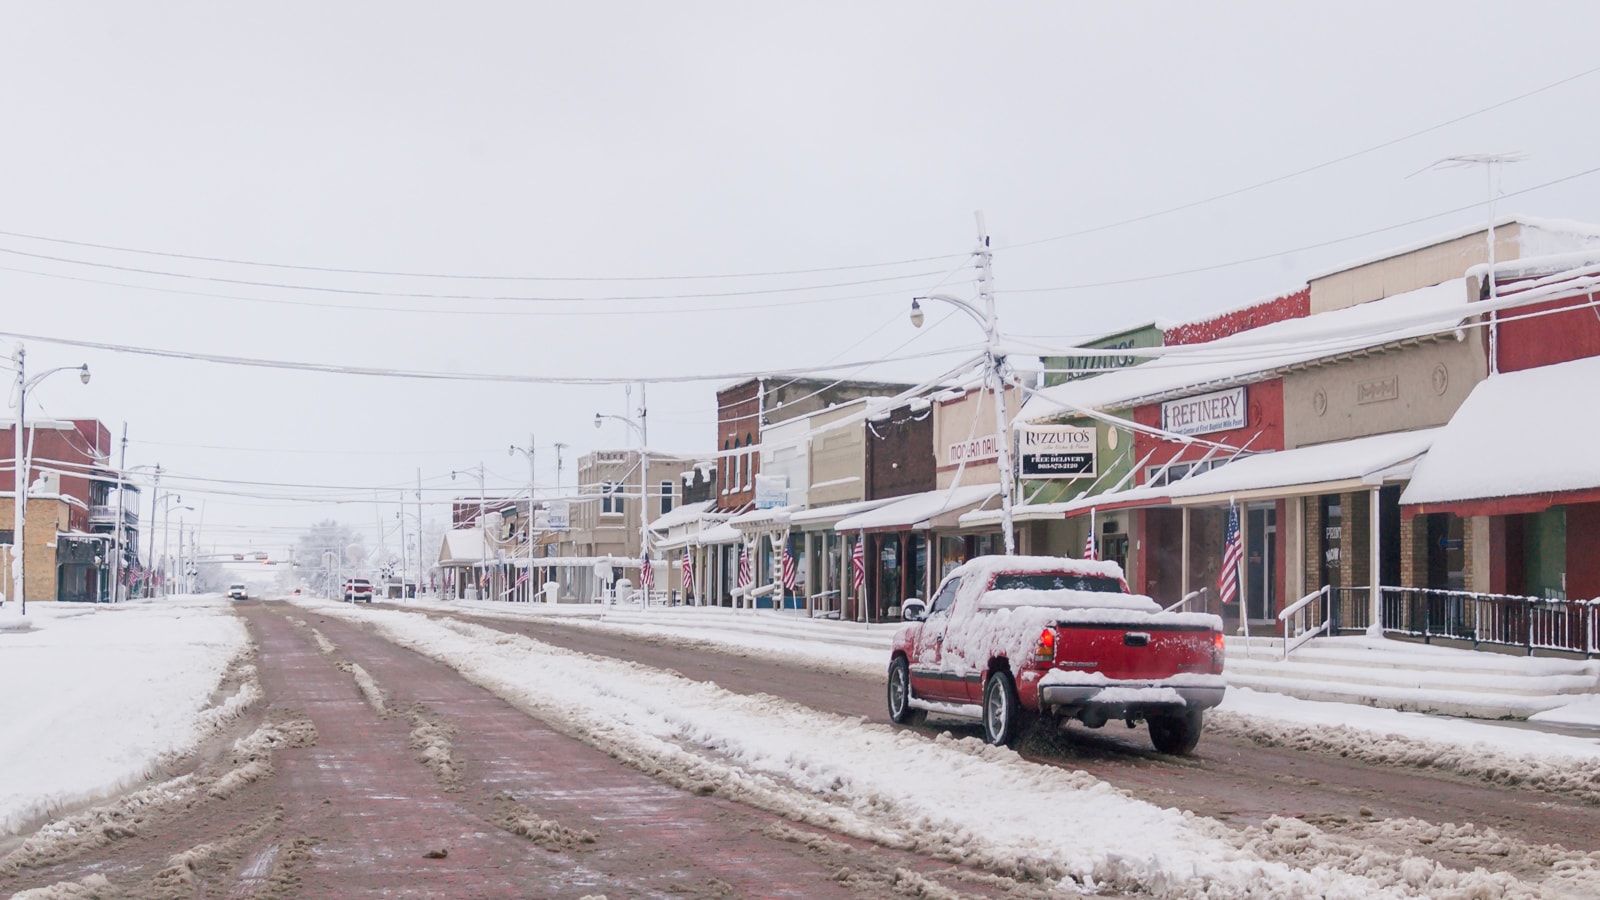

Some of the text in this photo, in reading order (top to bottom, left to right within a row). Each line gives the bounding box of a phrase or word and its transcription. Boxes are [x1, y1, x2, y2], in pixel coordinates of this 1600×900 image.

[1172, 390, 1241, 427] REFINERY
[1026, 430, 1090, 446] RIZZUTO'S
[951, 442, 980, 461] MORN
